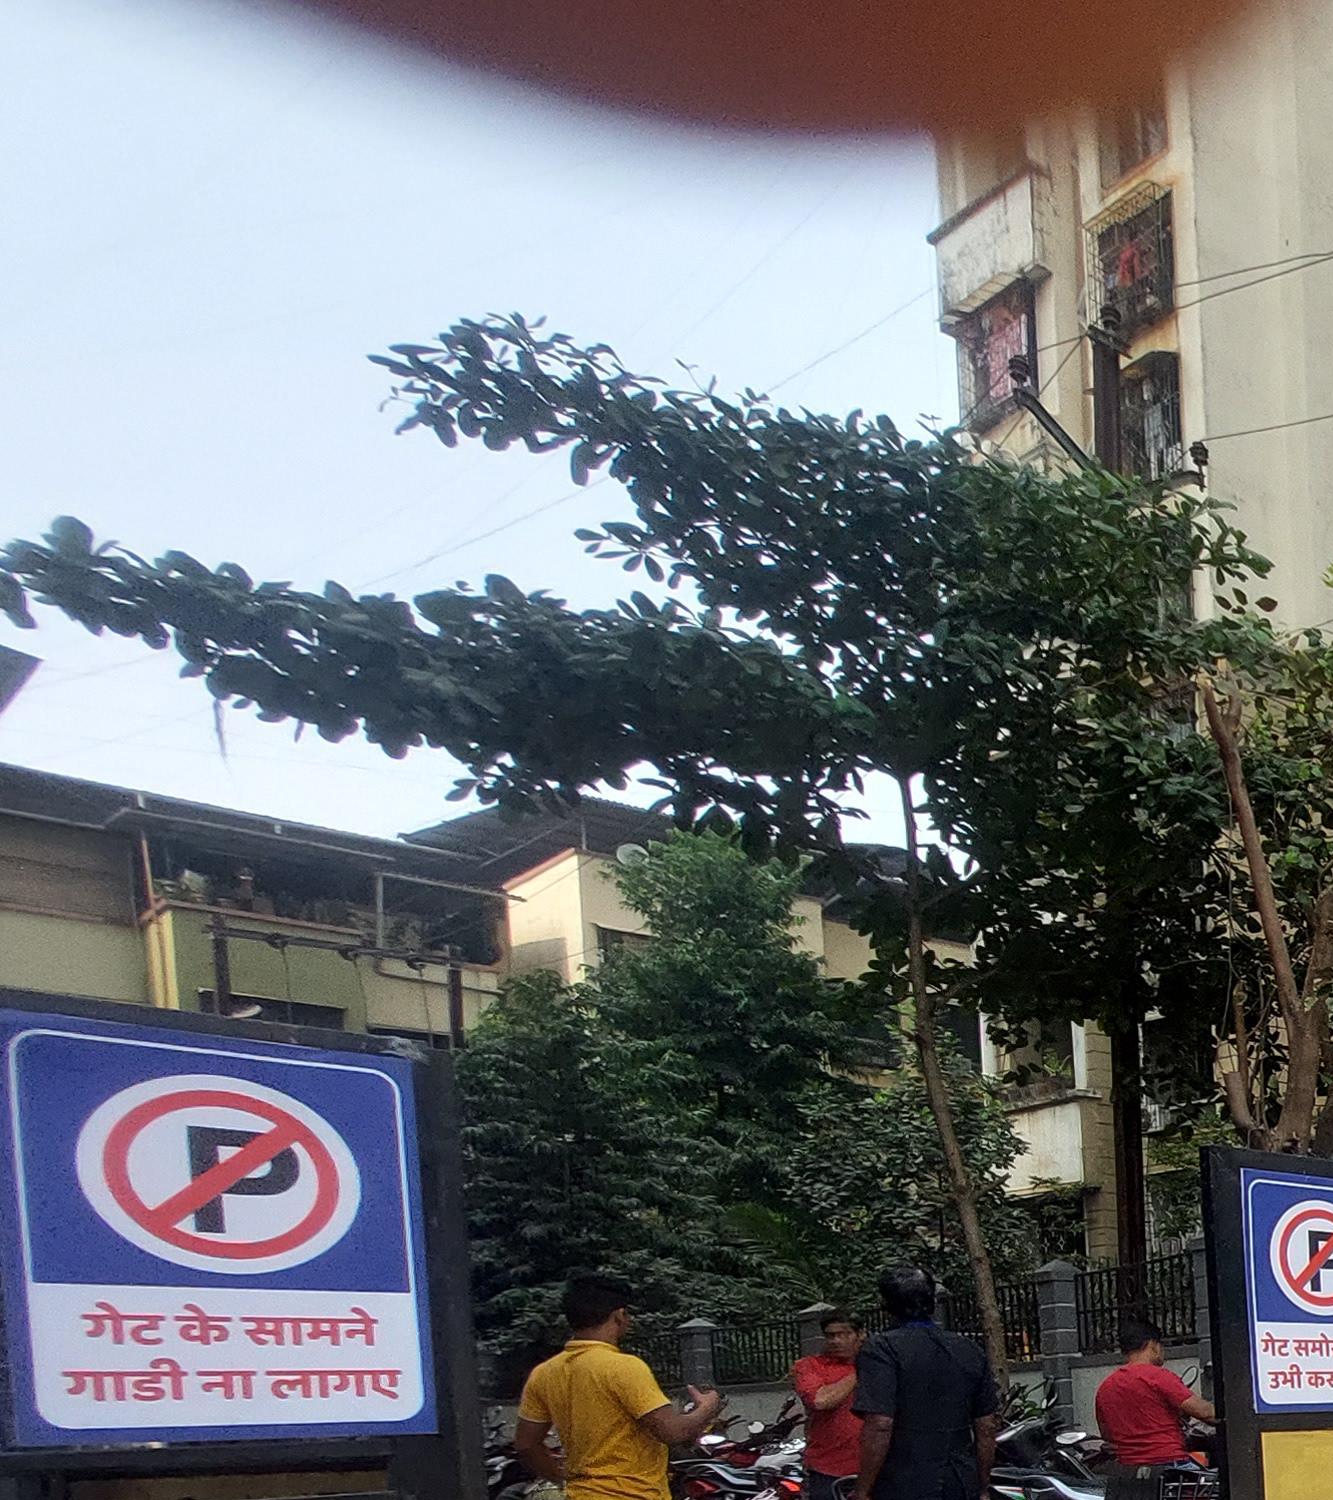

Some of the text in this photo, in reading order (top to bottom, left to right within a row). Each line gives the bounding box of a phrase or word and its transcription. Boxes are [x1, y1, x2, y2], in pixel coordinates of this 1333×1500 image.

[81, 1302, 379, 1347] गेट के सामने
[1261, 1332, 1289, 1357] गेट
[63, 1358, 402, 1402] गाडी ना लागए
[1267, 1364, 1303, 1389] उभी
